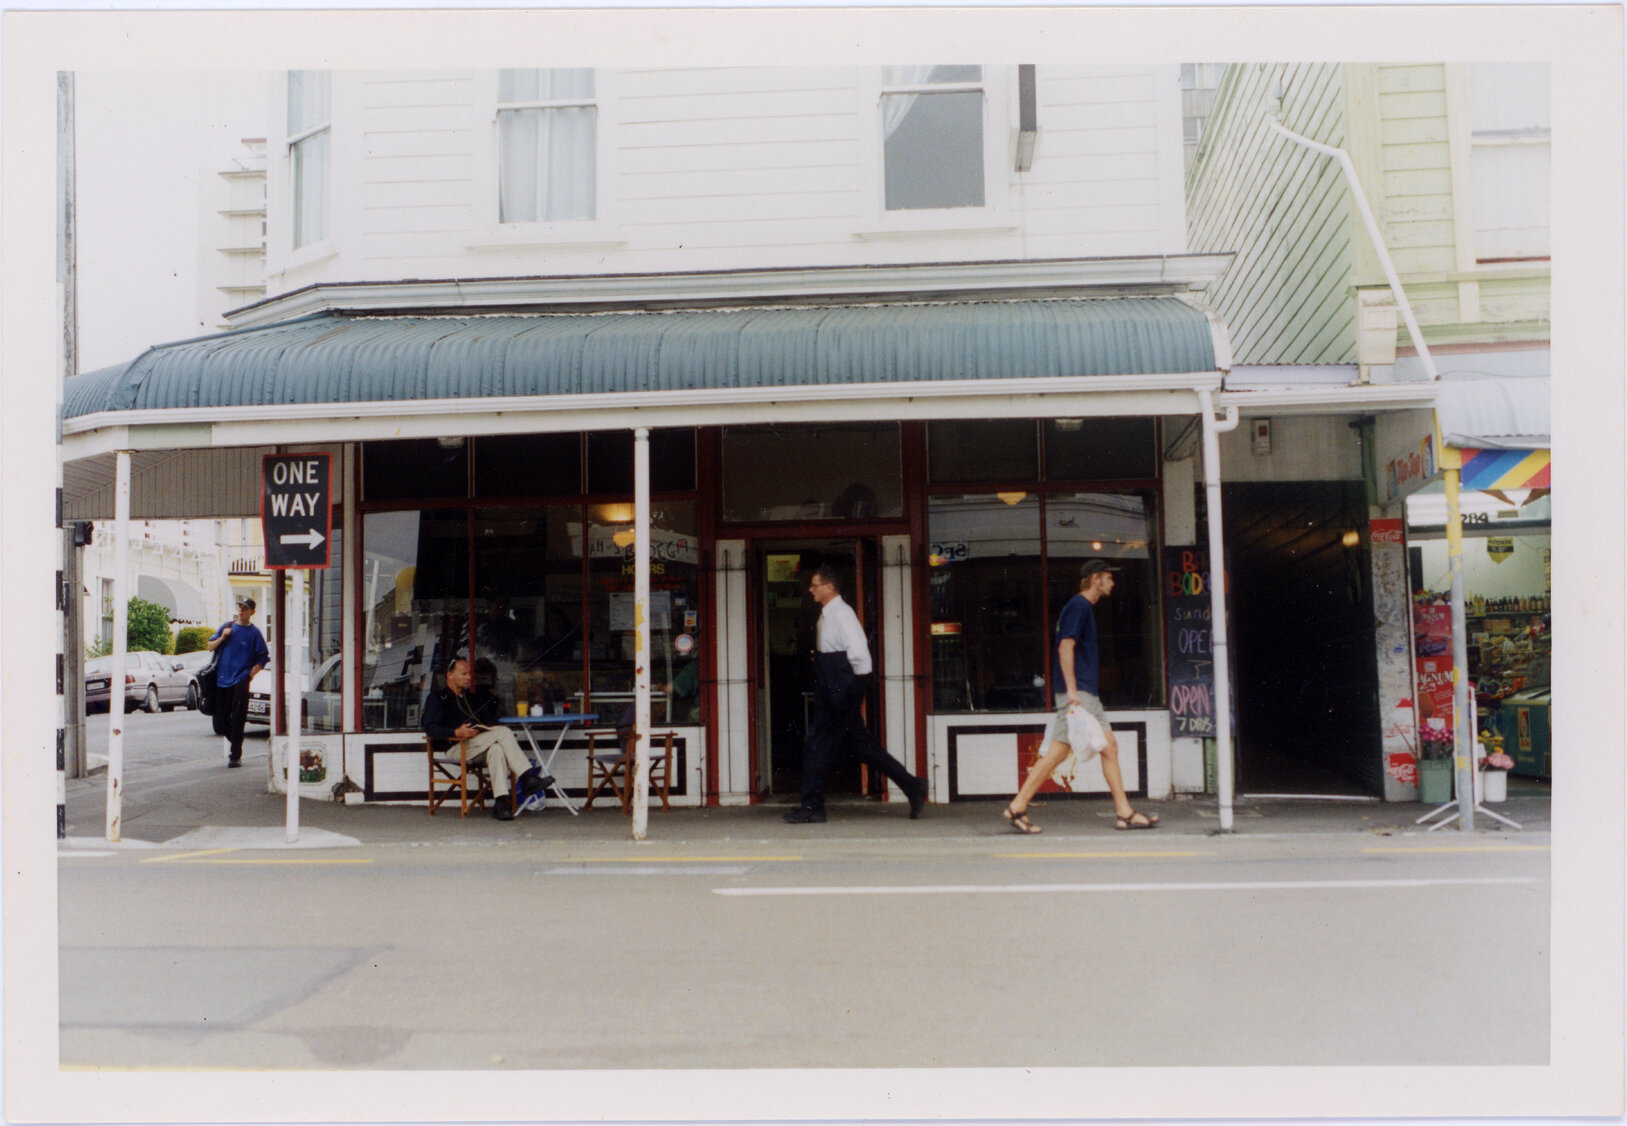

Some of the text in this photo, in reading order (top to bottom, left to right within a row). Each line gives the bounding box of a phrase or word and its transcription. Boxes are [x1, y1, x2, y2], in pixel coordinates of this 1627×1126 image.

[273, 461, 319, 485] ONE
[271, 492, 320, 517] WAY
[625, 538, 689, 562] BDEGA
[622, 563, 666, 576] HORS
[1179, 628, 1214, 654] OPE
